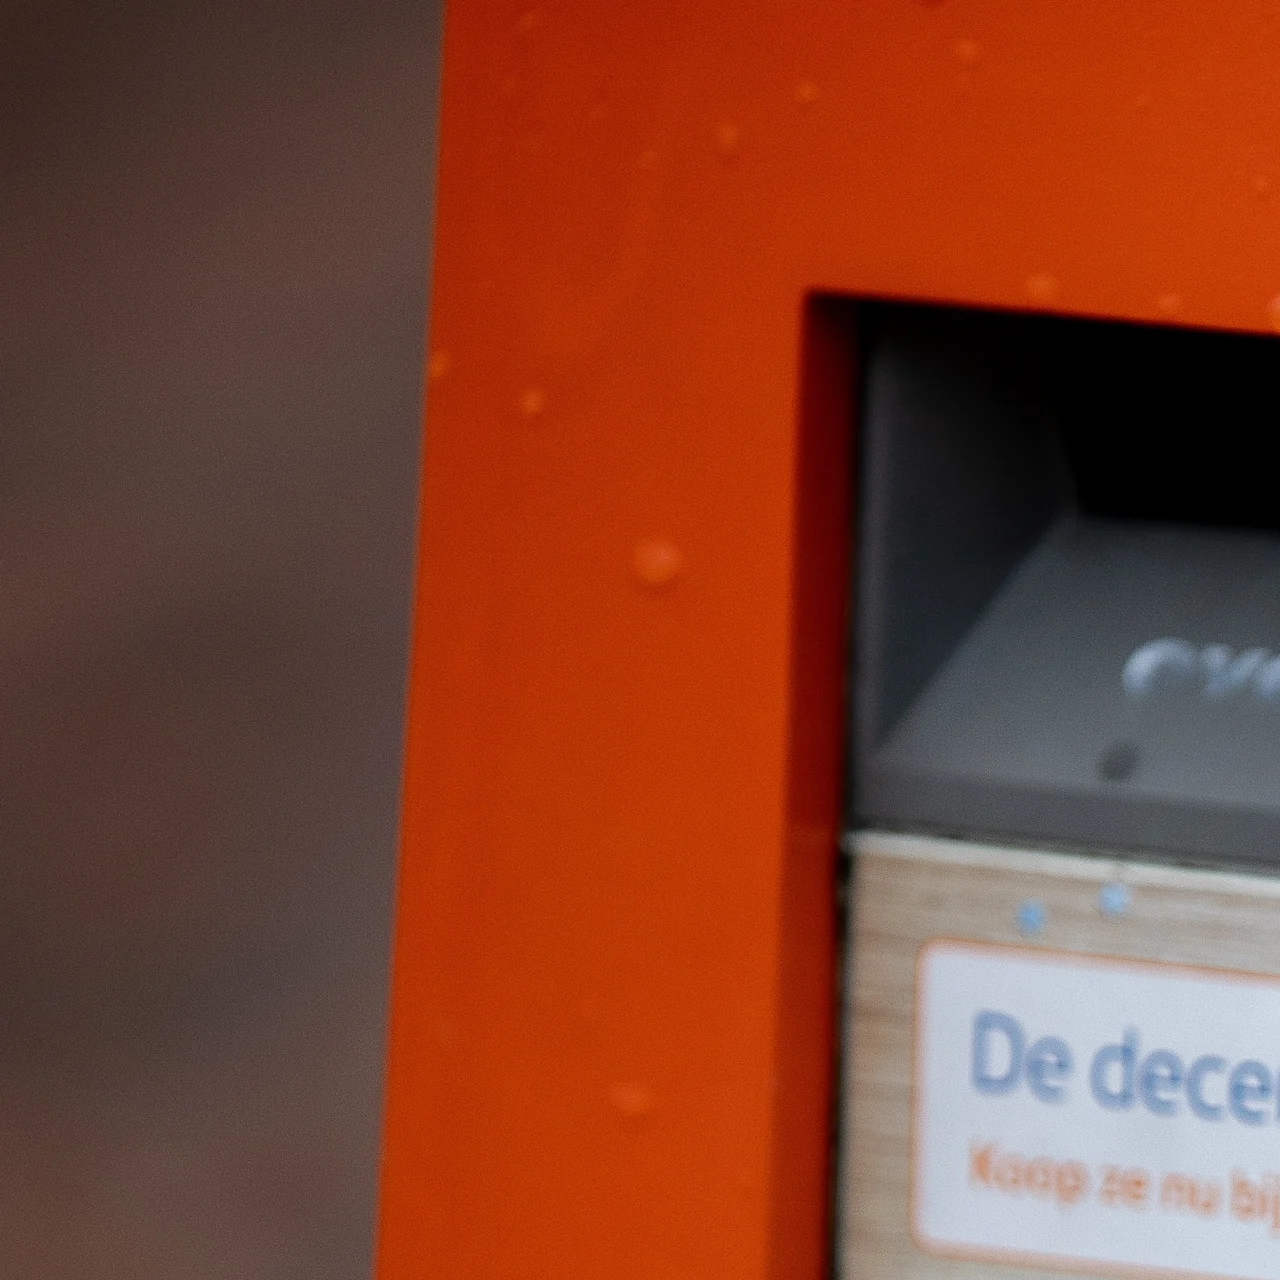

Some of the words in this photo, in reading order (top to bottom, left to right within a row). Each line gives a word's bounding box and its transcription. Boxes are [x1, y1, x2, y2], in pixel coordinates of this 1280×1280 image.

[968, 1007, 1074, 1105] De
[967, 1138, 1088, 1208] Koop
[1098, 1161, 1151, 1203] ze
[1160, 1170, 1220, 1217] nu
